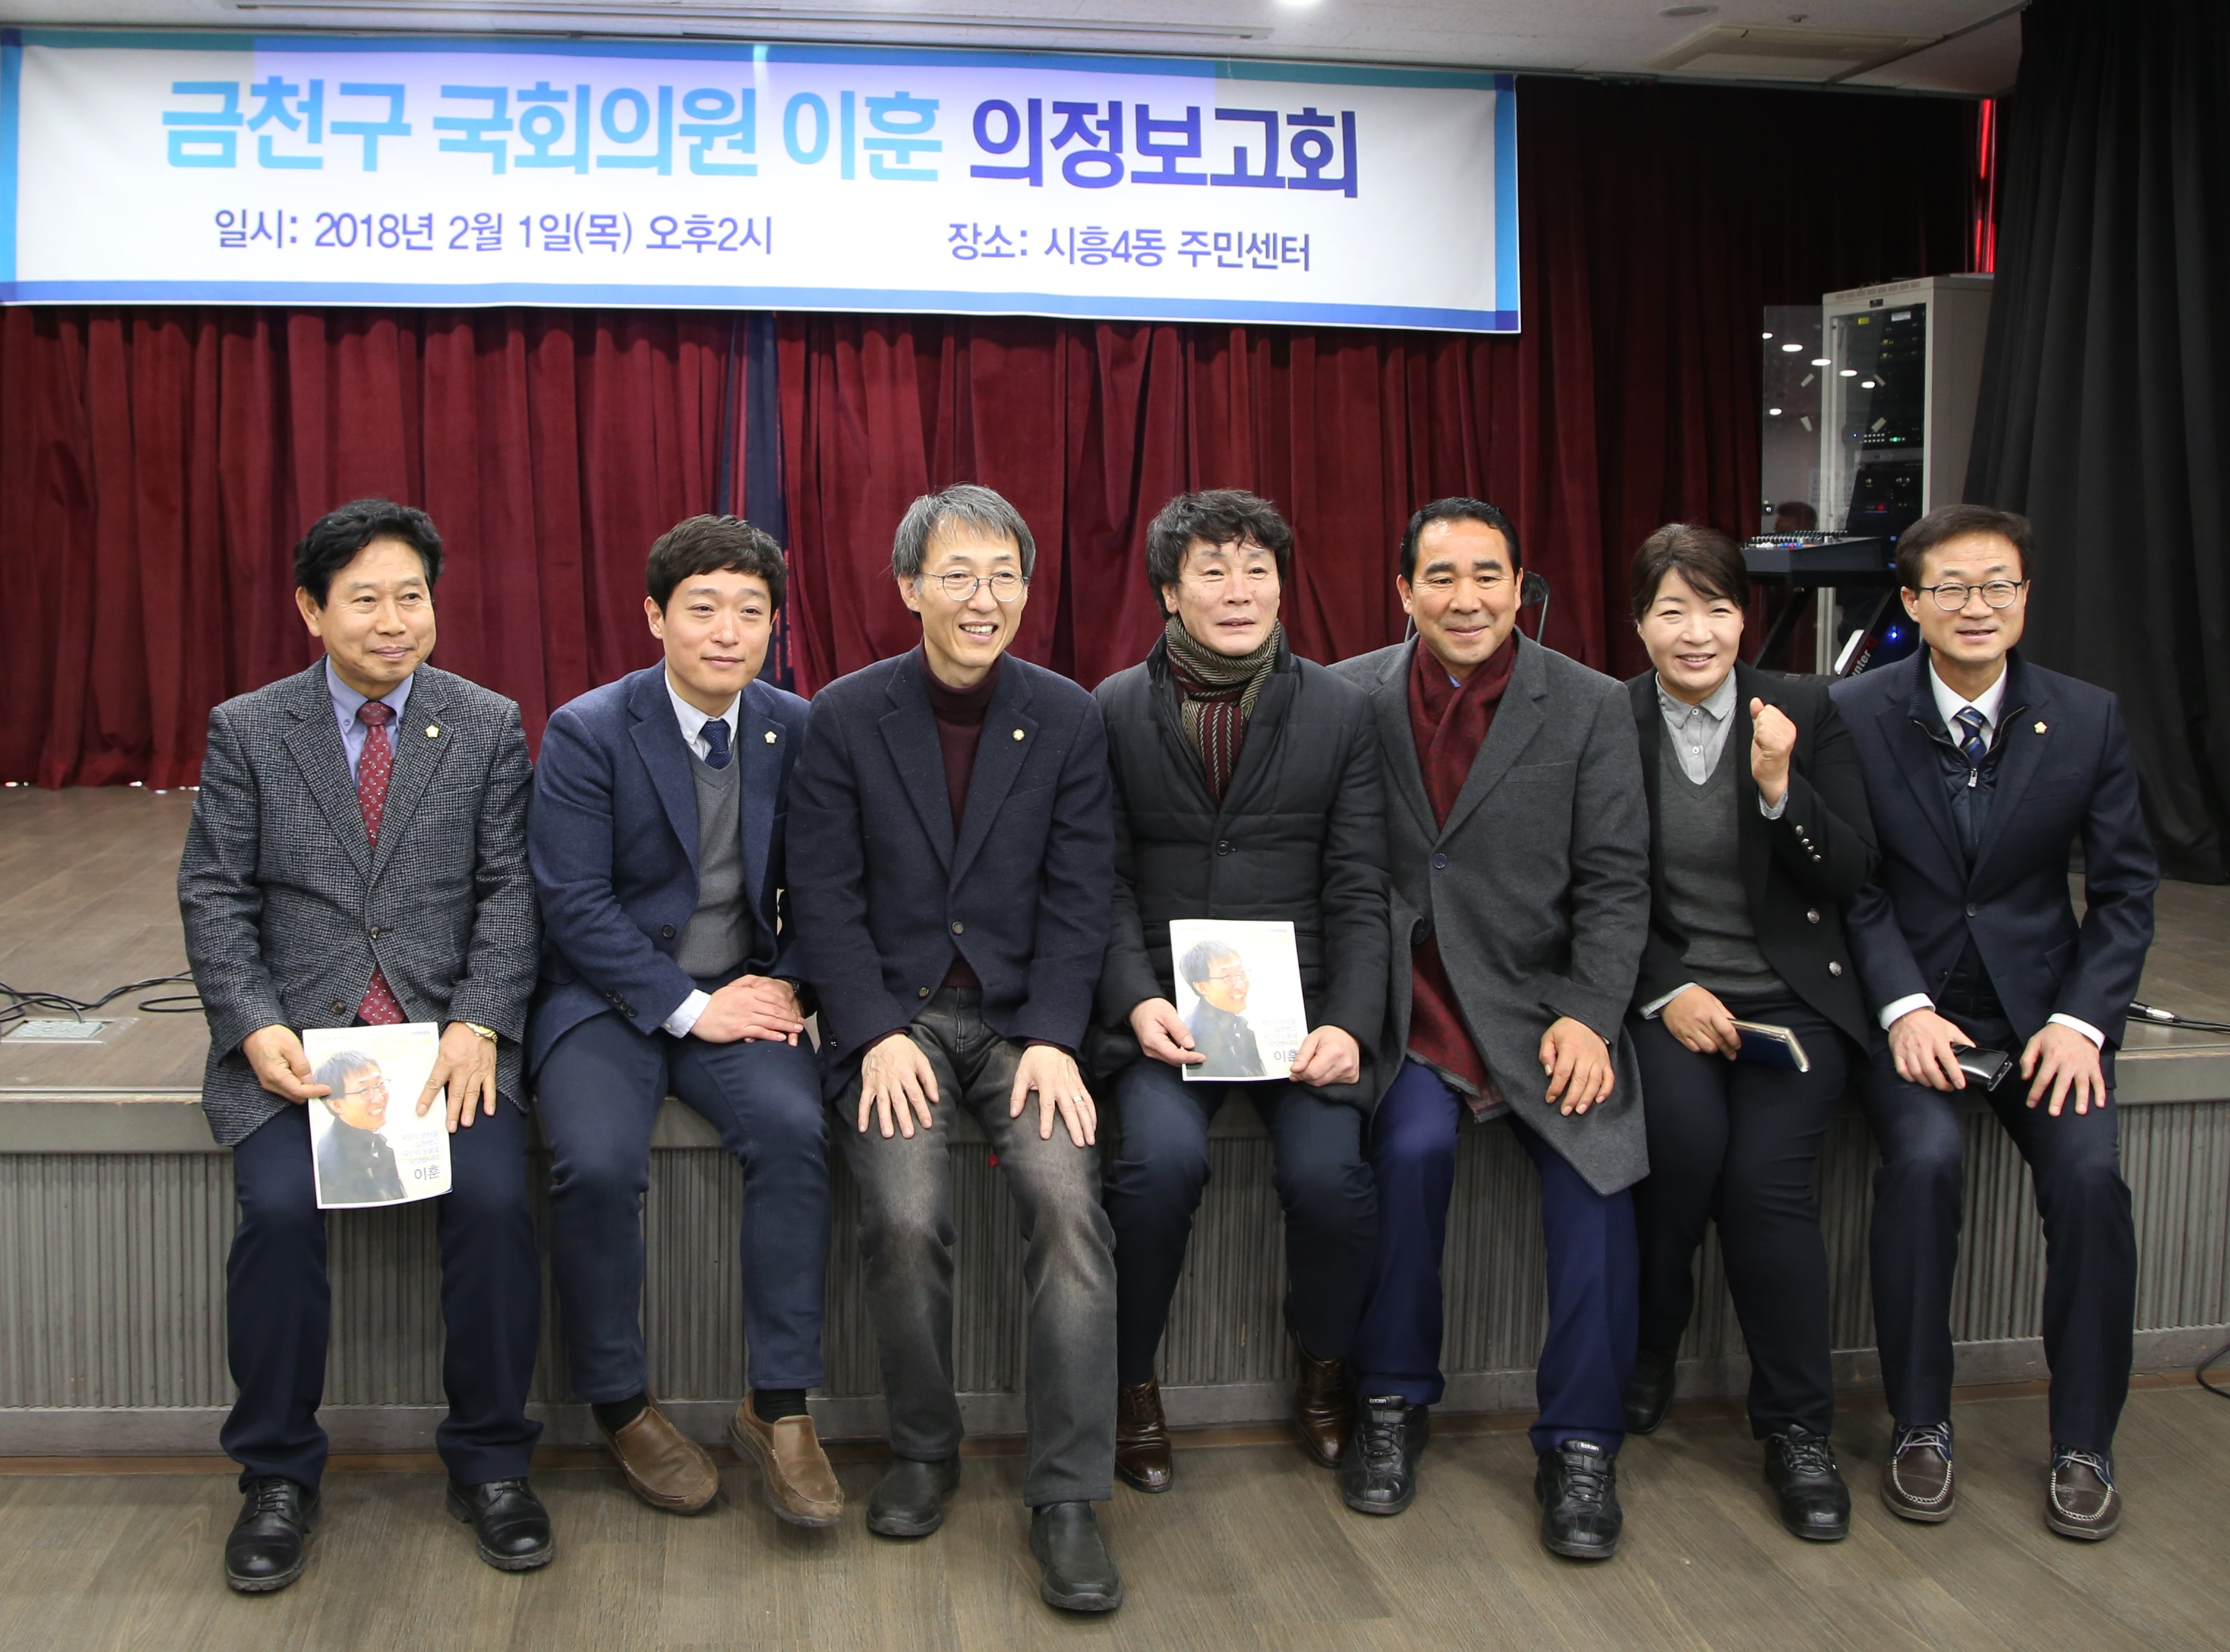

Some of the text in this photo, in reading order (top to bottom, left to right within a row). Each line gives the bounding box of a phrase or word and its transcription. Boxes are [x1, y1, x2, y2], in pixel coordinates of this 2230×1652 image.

[161, 75, 1358, 198] 금천구 국회의원 이훈 의정보고회
[215, 209, 772, 255] 일시: 2018년 2월 1일(목) 오후2시
[948, 222, 1310, 272] 장소: 시흥4동 주민센터
[1274, 1049, 1298, 1063] 이훈
[414, 1165, 440, 1181] 이훈
